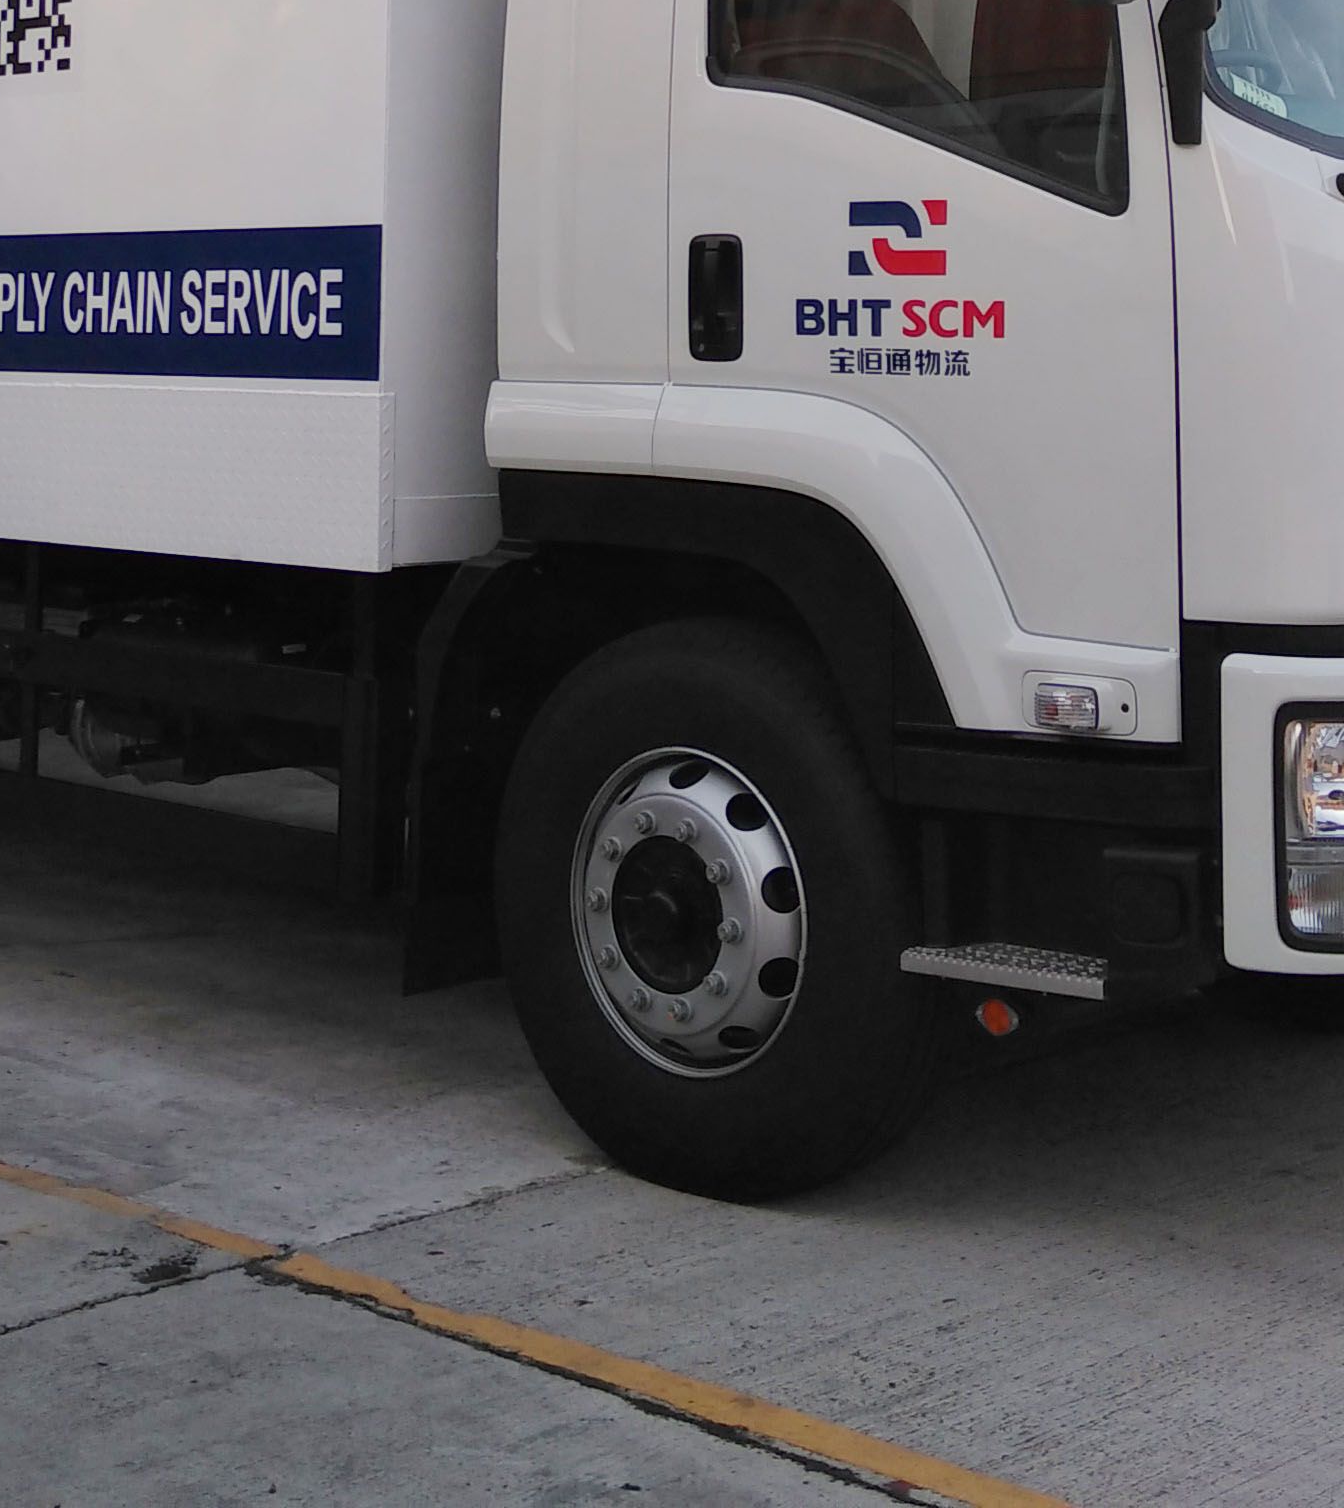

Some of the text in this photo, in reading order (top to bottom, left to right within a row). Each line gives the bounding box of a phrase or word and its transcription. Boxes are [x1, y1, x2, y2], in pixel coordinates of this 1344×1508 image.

[62, 270, 171, 336] CHAIN
[180, 269, 344, 340] SERVICE
[795, 298, 1006, 340] BHT SCM
[829, 348, 972, 377] 宝恒通物流
